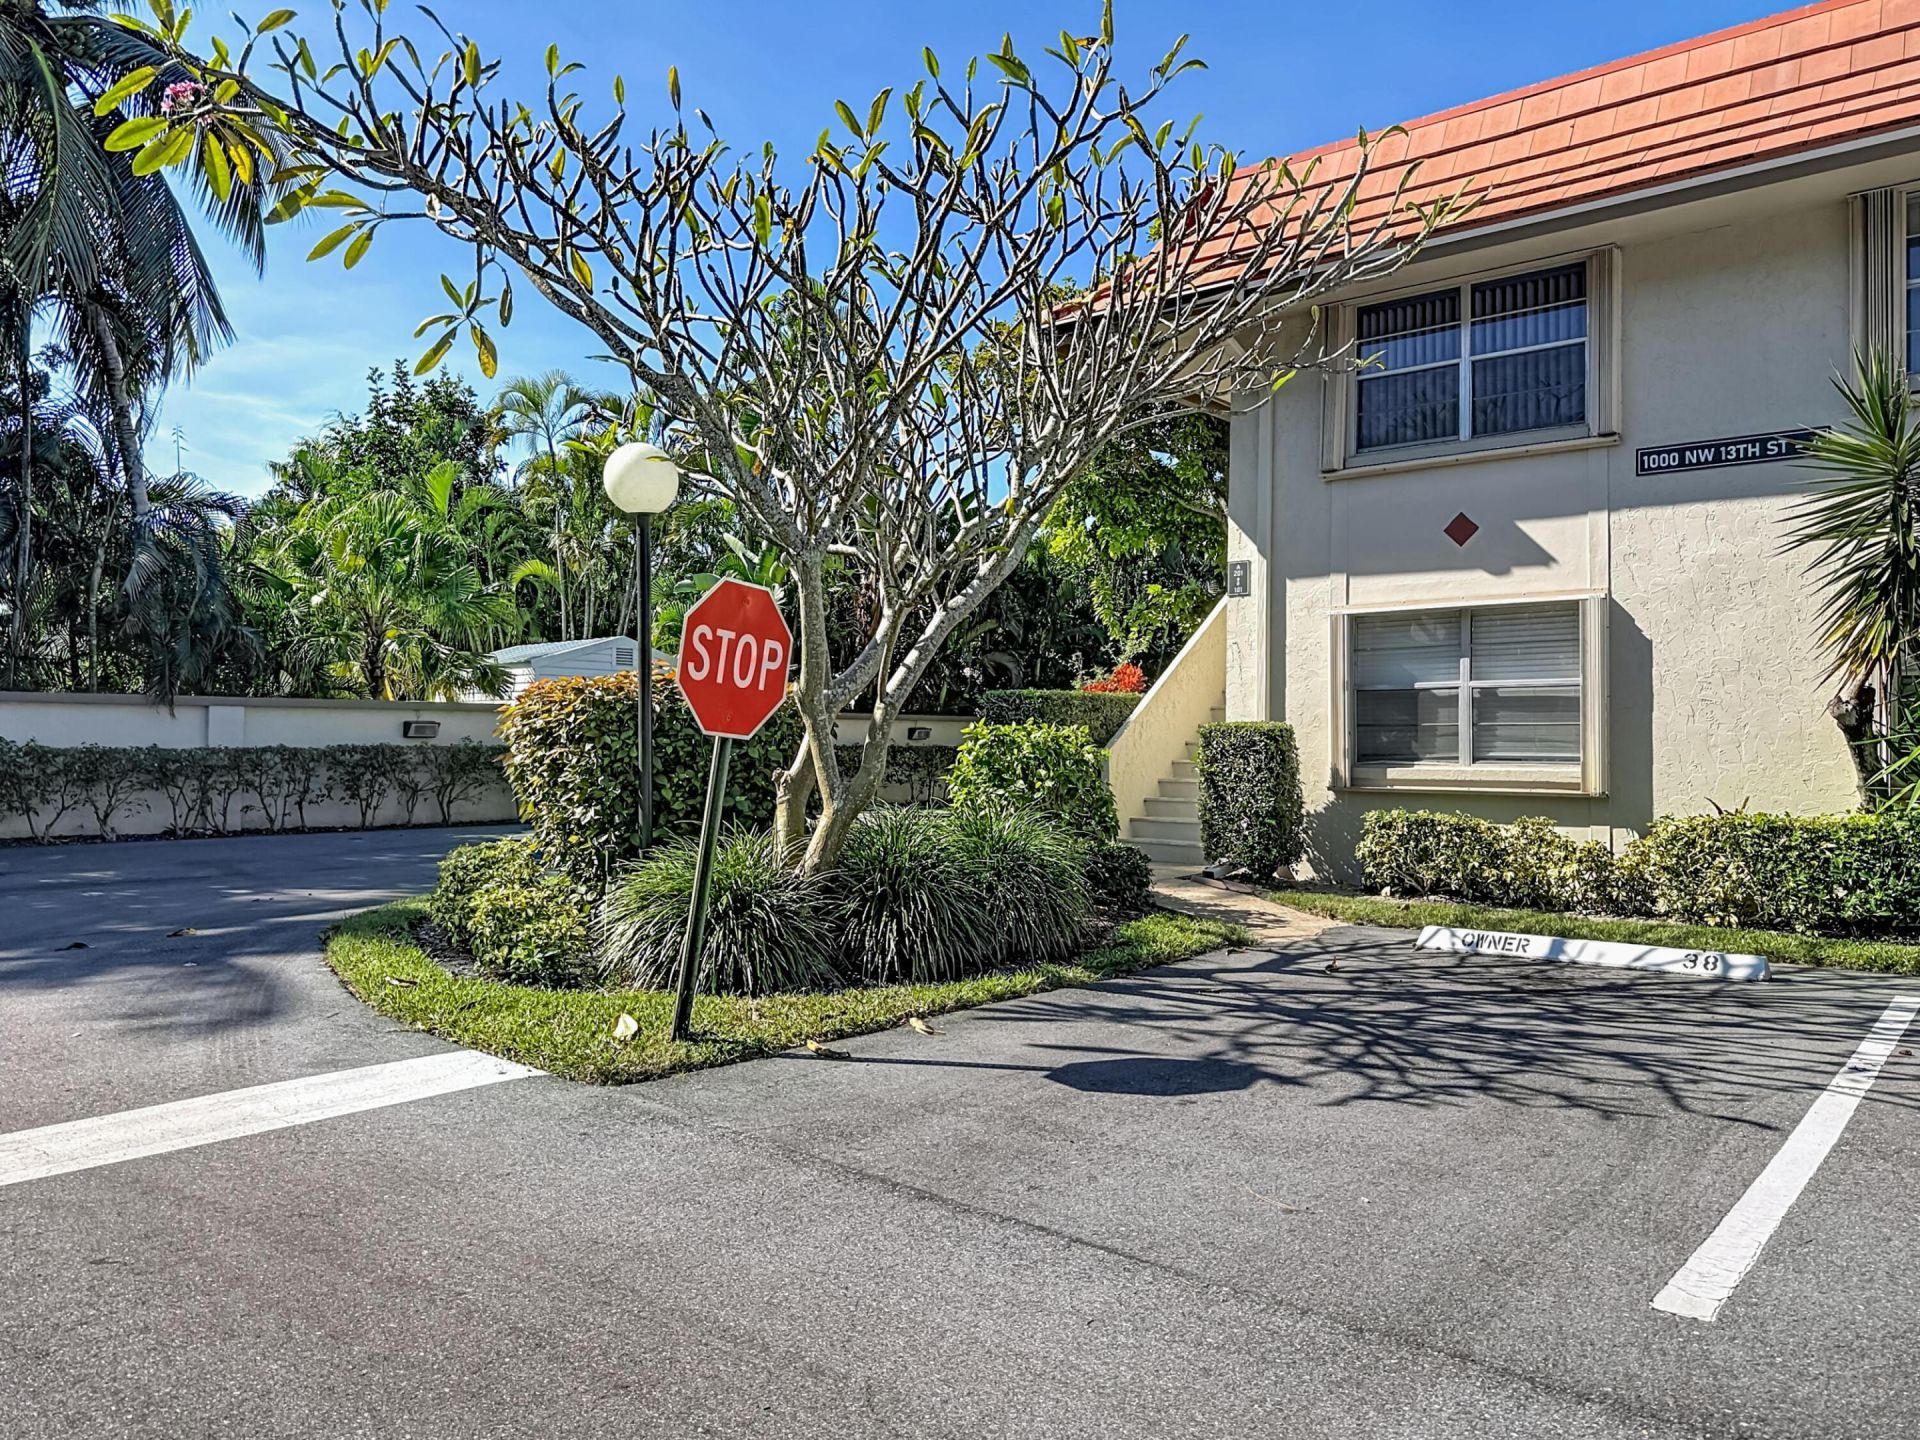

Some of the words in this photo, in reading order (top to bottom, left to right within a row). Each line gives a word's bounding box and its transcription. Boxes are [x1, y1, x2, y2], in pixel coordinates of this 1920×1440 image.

[1642, 452, 1679, 469] 1000
[1685, 447, 1715, 464] NW
[1719, 442, 1760, 460] 13TH
[1766, 440, 1786, 455] ST
[687, 624, 783, 691] STOP
[1461, 932, 1530, 953] OWNER
[1682, 953, 1719, 972] 38
